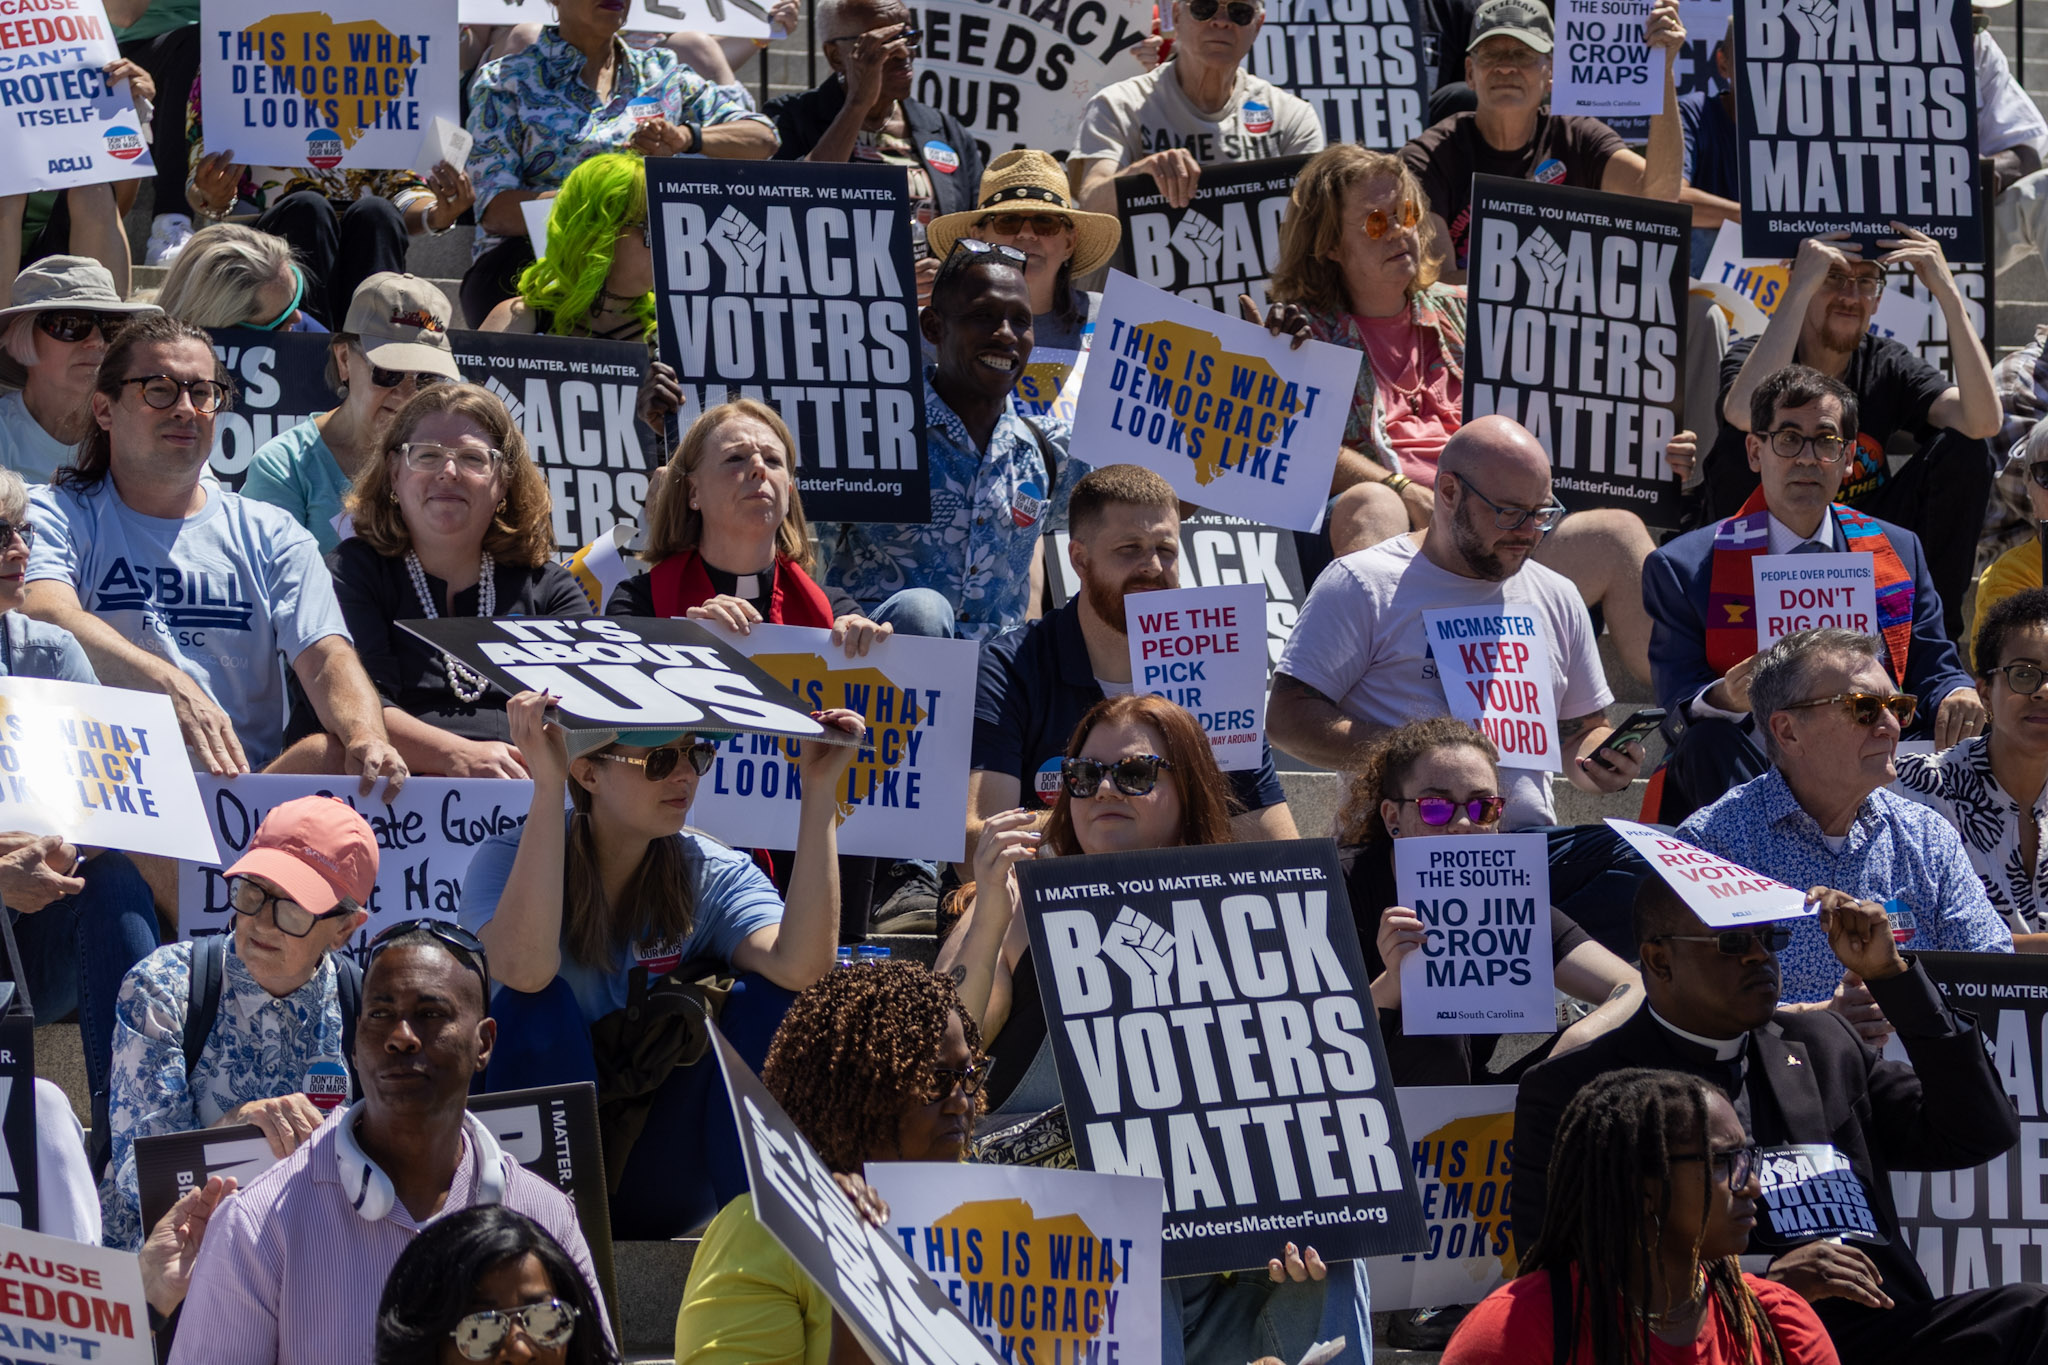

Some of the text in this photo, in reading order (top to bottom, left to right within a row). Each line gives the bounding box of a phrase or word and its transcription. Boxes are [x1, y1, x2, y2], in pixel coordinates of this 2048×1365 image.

[0, 0, 79, 16] CAUSE
[1571, 1, 1598, 14] THE
[0, 15, 104, 50] EEDOM
[1566, 21, 1606, 42] NO
[1744, 0, 1962, 65] BACK
[218, 31, 430, 64] THIS IS WHAT
[1243, 24, 1417, 86] OTERS
[1569, 44, 1652, 64] CROW
[0, 67, 115, 107] ROTECT
[232, 65, 418, 97] DEMOCRACY
[1571, 65, 1648, 84] MAPS
[244, 98, 420, 130] LOOKS LIKE
[918, 69, 1021, 133] OUR
[1746, 62, 1968, 140] VOTERS
[17, 106, 94, 127] ITSELF
[1633, 118, 1647, 127] for
[309, 141, 341, 149] DON'T RIG
[1140, 124, 1285, 161] SAME SHIT
[48, 155, 93, 174] ACLU
[1749, 140, 1972, 216] MATTER
[659, 182, 897, 201] I MATTER. YOU MATTER. WE MATTER.
[1127, 179, 1286, 208] I MATTER. WE
[1482, 199, 1681, 238] I MATTER. YOU MATTER. WE MATTER.
[662, 202, 904, 298] BACK
[1478, 217, 1678, 326] BACK
[1720, 261, 1780, 307] THIS
[668, 295, 912, 385] VOTERS
[1477, 302, 1678, 403] VOTERS
[488, 356, 515, 368] YOU
[518, 358, 567, 372] MATTER.
[569, 362, 589, 374] WE
[591, 364, 640, 377] MATTER.
[1109, 318, 1321, 418] THIS IS WHAT
[1109, 358, 1299, 449] DEMOCRACY
[1111, 397, 1291, 485] LOOKS LIKE
[1849, 477, 1877, 497] THE
[1201, 515, 1223, 525] WE
[99, 557, 253, 609] ASBILL
[1761, 568, 1871, 581] PEOPLE OVER POLITICS:
[1780, 587, 1855, 610] DON'T
[492, 619, 642, 643] IT'S
[1138, 607, 1237, 634] WE THE
[1436, 616, 1536, 640] MCMASTER
[1768, 615, 1811, 637] RIG
[179, 631, 206, 647] SC
[1141, 633, 1240, 660] PEOPLE
[477, 642, 732, 670] ABOUT
[1458, 642, 1529, 674] KEEP
[1144, 661, 1206, 685] PICK
[500, 664, 825, 735] US
[844, 682, 941, 727] WHAT
[1466, 679, 1541, 715] YOUR
[1199, 709, 1255, 732] DERS
[1211, 732, 1257, 746] WAY AROUND
[1473, 718, 1548, 756] WORD
[76, 779, 160, 818] LIKE
[714, 757, 921, 810] LOOK LIKE
[1041, 782, 1056, 790] OUR
[1430, 850, 1516, 868] PROTECT
[1657, 852, 1710, 867] RIG
[1035, 867, 1327, 902] I MATTER. YOU MATTER. WE MATTER.
[1416, 869, 1531, 888] THE SOUTH:
[1706, 879, 1793, 899] MAPS
[1415, 898, 1535, 927] NO JIM
[1899, 920, 1914, 928] MAPS
[1042, 890, 1353, 1015] BACK
[1421, 928, 1532, 958] CROW
[1426, 958, 1532, 988] MAPS
[1955, 983, 1987, 997] YOU
[1436, 1010, 1525, 1019] ACLU South Carolina
[1064, 995, 1377, 1115] VOTERS
[310, 1084, 347, 1093] OUR MAPS
[311, 1076, 347, 1084] DON'T RIG
[552, 1110, 573, 1185] MATTER.
[1086, 1097, 1403, 1213] MATTER
[1411, 1140, 1469, 1179] HIS
[1761, 1180, 1869, 1209] VOTERS
[1768, 1203, 1878, 1233] MATTER
[897, 1227, 1133, 1284] THIS IS WHAT
[1402, 1220, 1513, 1262] OOKS
[0, 1251, 103, 1290] AUSE
[931, 1279, 1119, 1335] EMOCRACY
